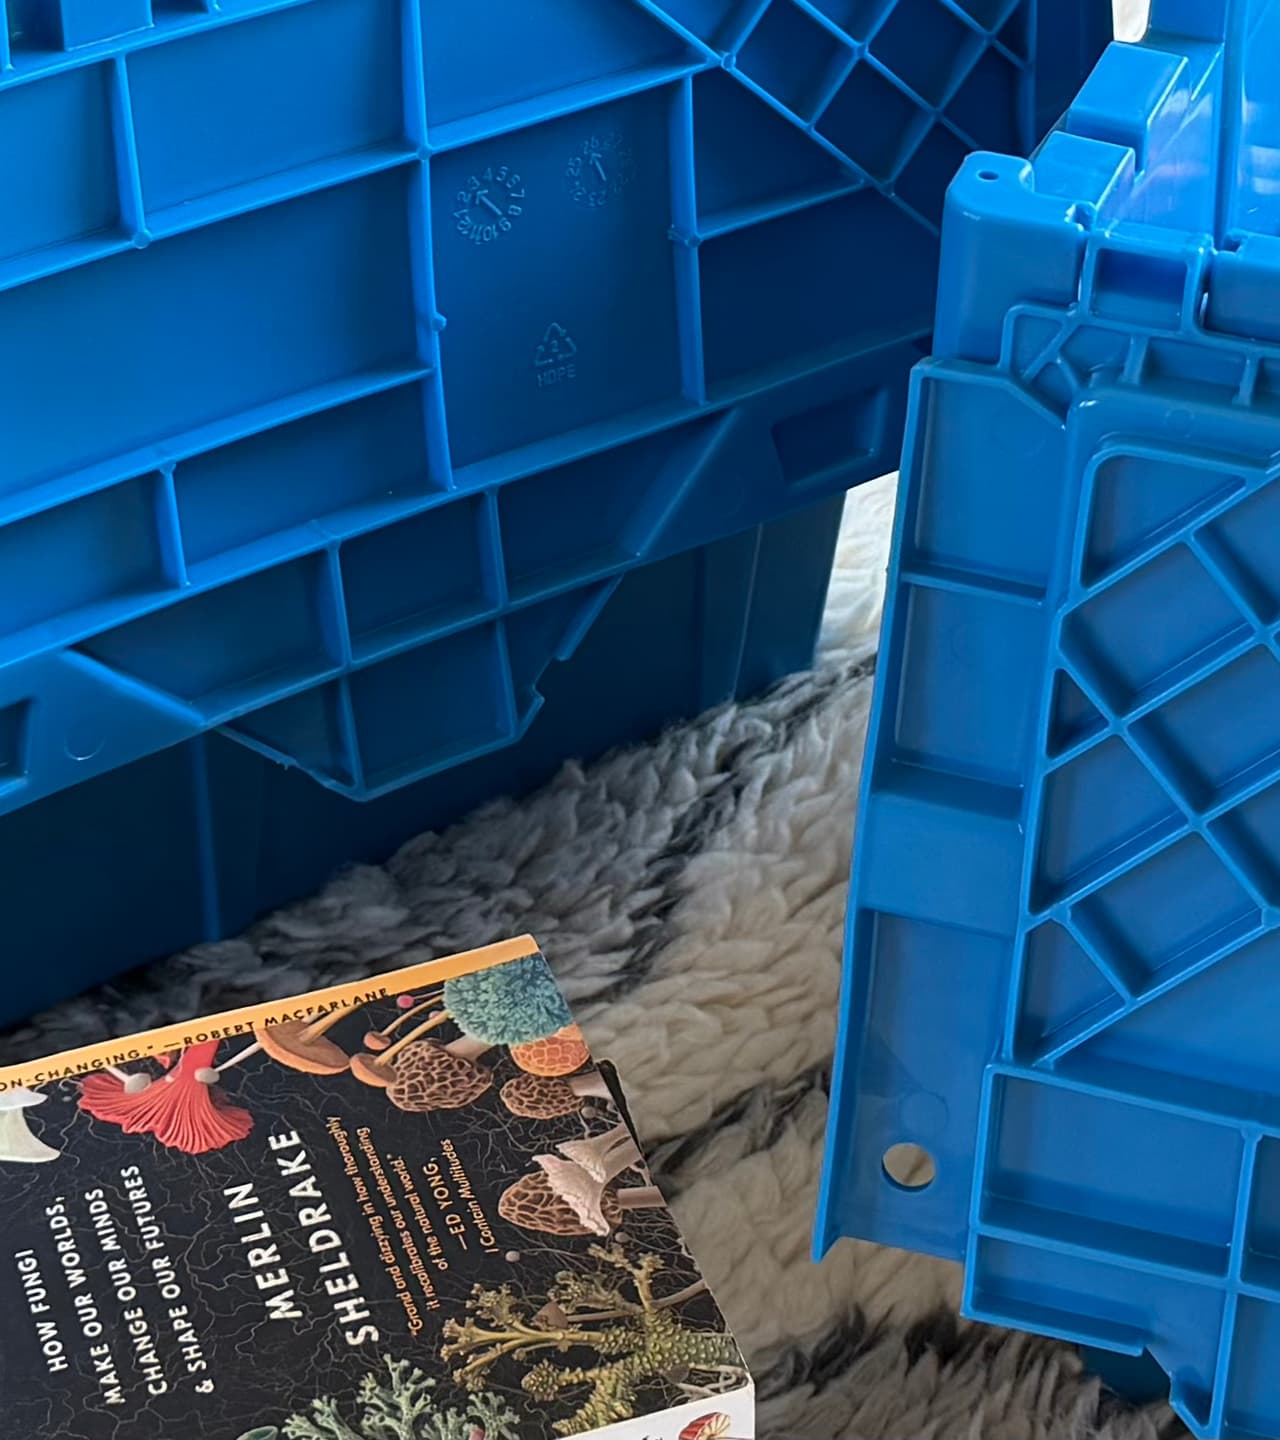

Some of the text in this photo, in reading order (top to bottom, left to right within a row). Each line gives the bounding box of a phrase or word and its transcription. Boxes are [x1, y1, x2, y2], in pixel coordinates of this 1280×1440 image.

[263, 987, 389, 1030] MACFARLANE
[326, 1116, 359, 1176] thoroughly
[439, 1138, 476, 1199] Multitudes
[352, 1176, 370, 1203] how
[361, 1202, 375, 1215] in
[423, 1157, 454, 1210] YONG,
[268, 1129, 380, 1346] SHELDRAKE
[356, 1126, 441, 1311] it recalibrates our understanding
[369, 1215, 397, 1264] dizzying
[404, 1192, 433, 1234] natural
[466, 1200, 496, 1246] Contain
[223, 1181, 304, 1320] MERLIN
[426, 1233, 443, 1257] the
[432, 1258, 449, 1271] of
[45, 1196, 126, 1405] MAKE OUR WORLDS,
[84, 1188, 169, 1396] CHANGE OUR MINDS
[120, 1165, 215, 1394] & SHAPE OUR FUTURES
[385, 1264, 407, 1290] and
[15, 1248, 69, 1373] HOW FUNGI
